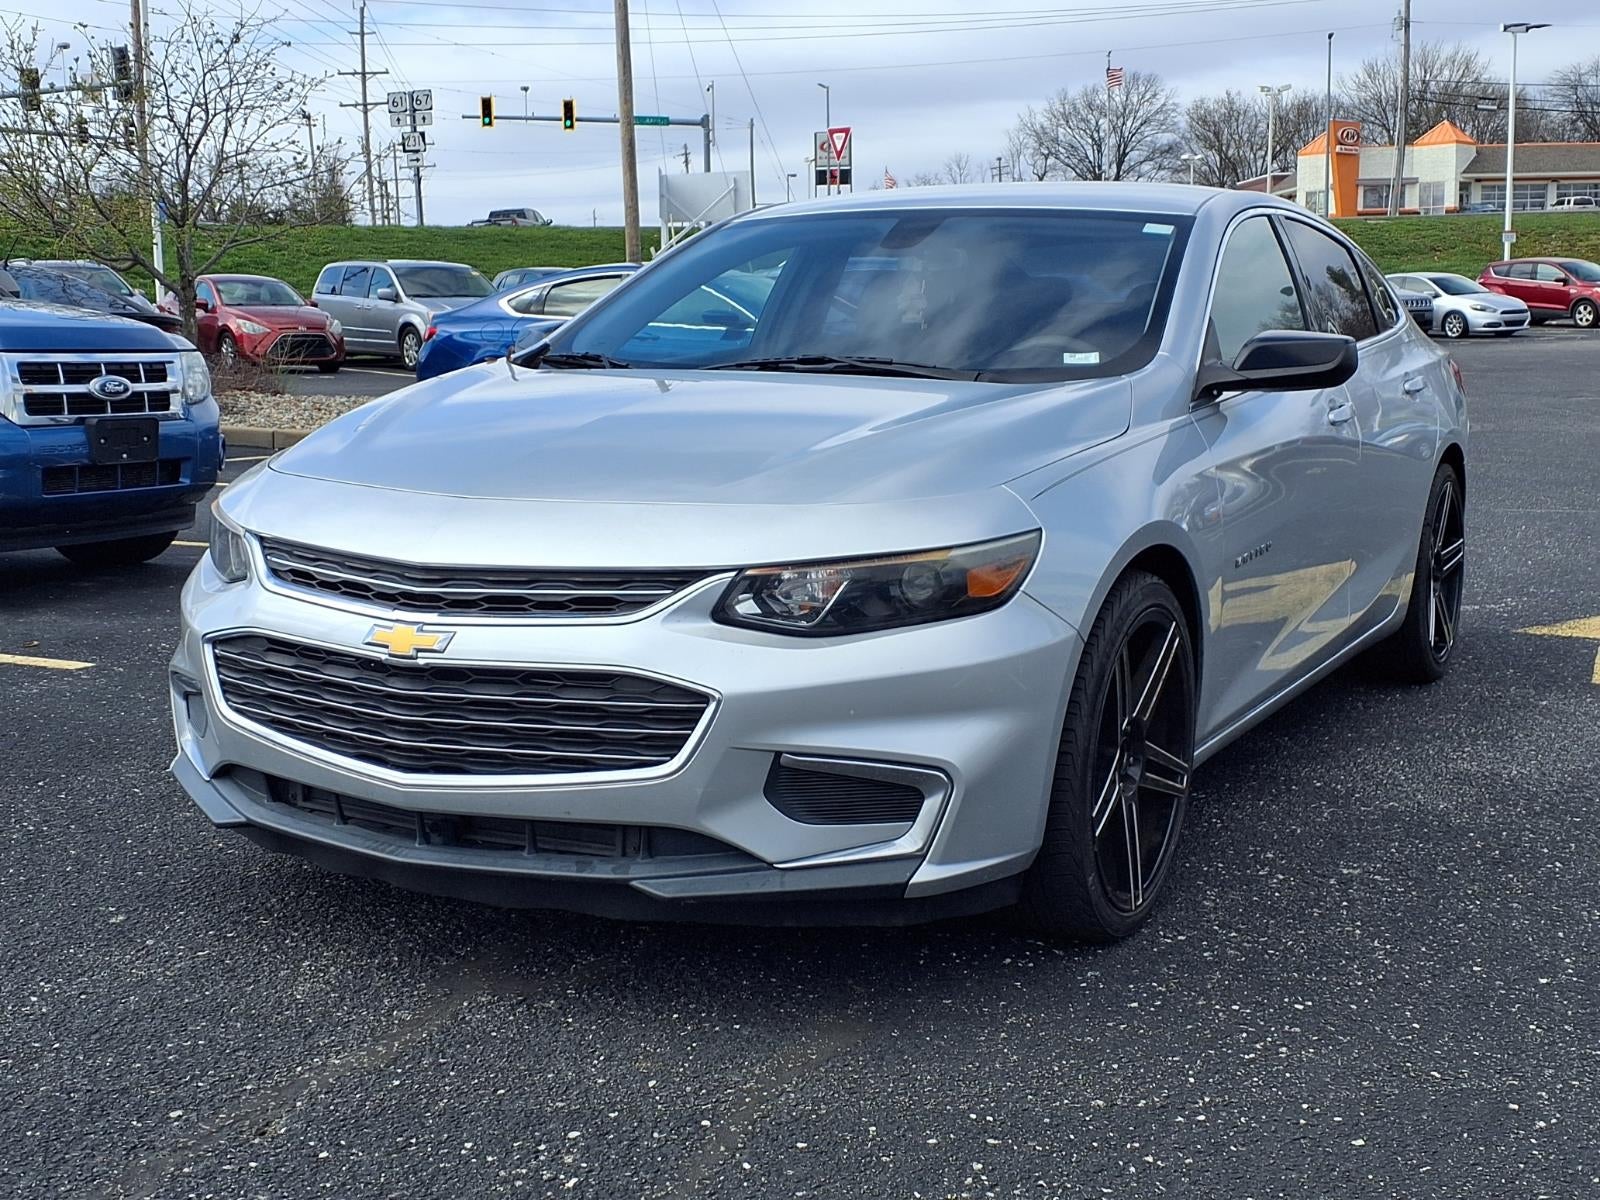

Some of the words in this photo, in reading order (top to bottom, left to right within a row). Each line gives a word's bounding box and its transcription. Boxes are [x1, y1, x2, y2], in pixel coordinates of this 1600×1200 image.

[391, 96, 403, 107] 61
[415, 93, 430, 106] 67
[406, 135, 421, 147] 231
[104, 381, 124, 392] Ford
